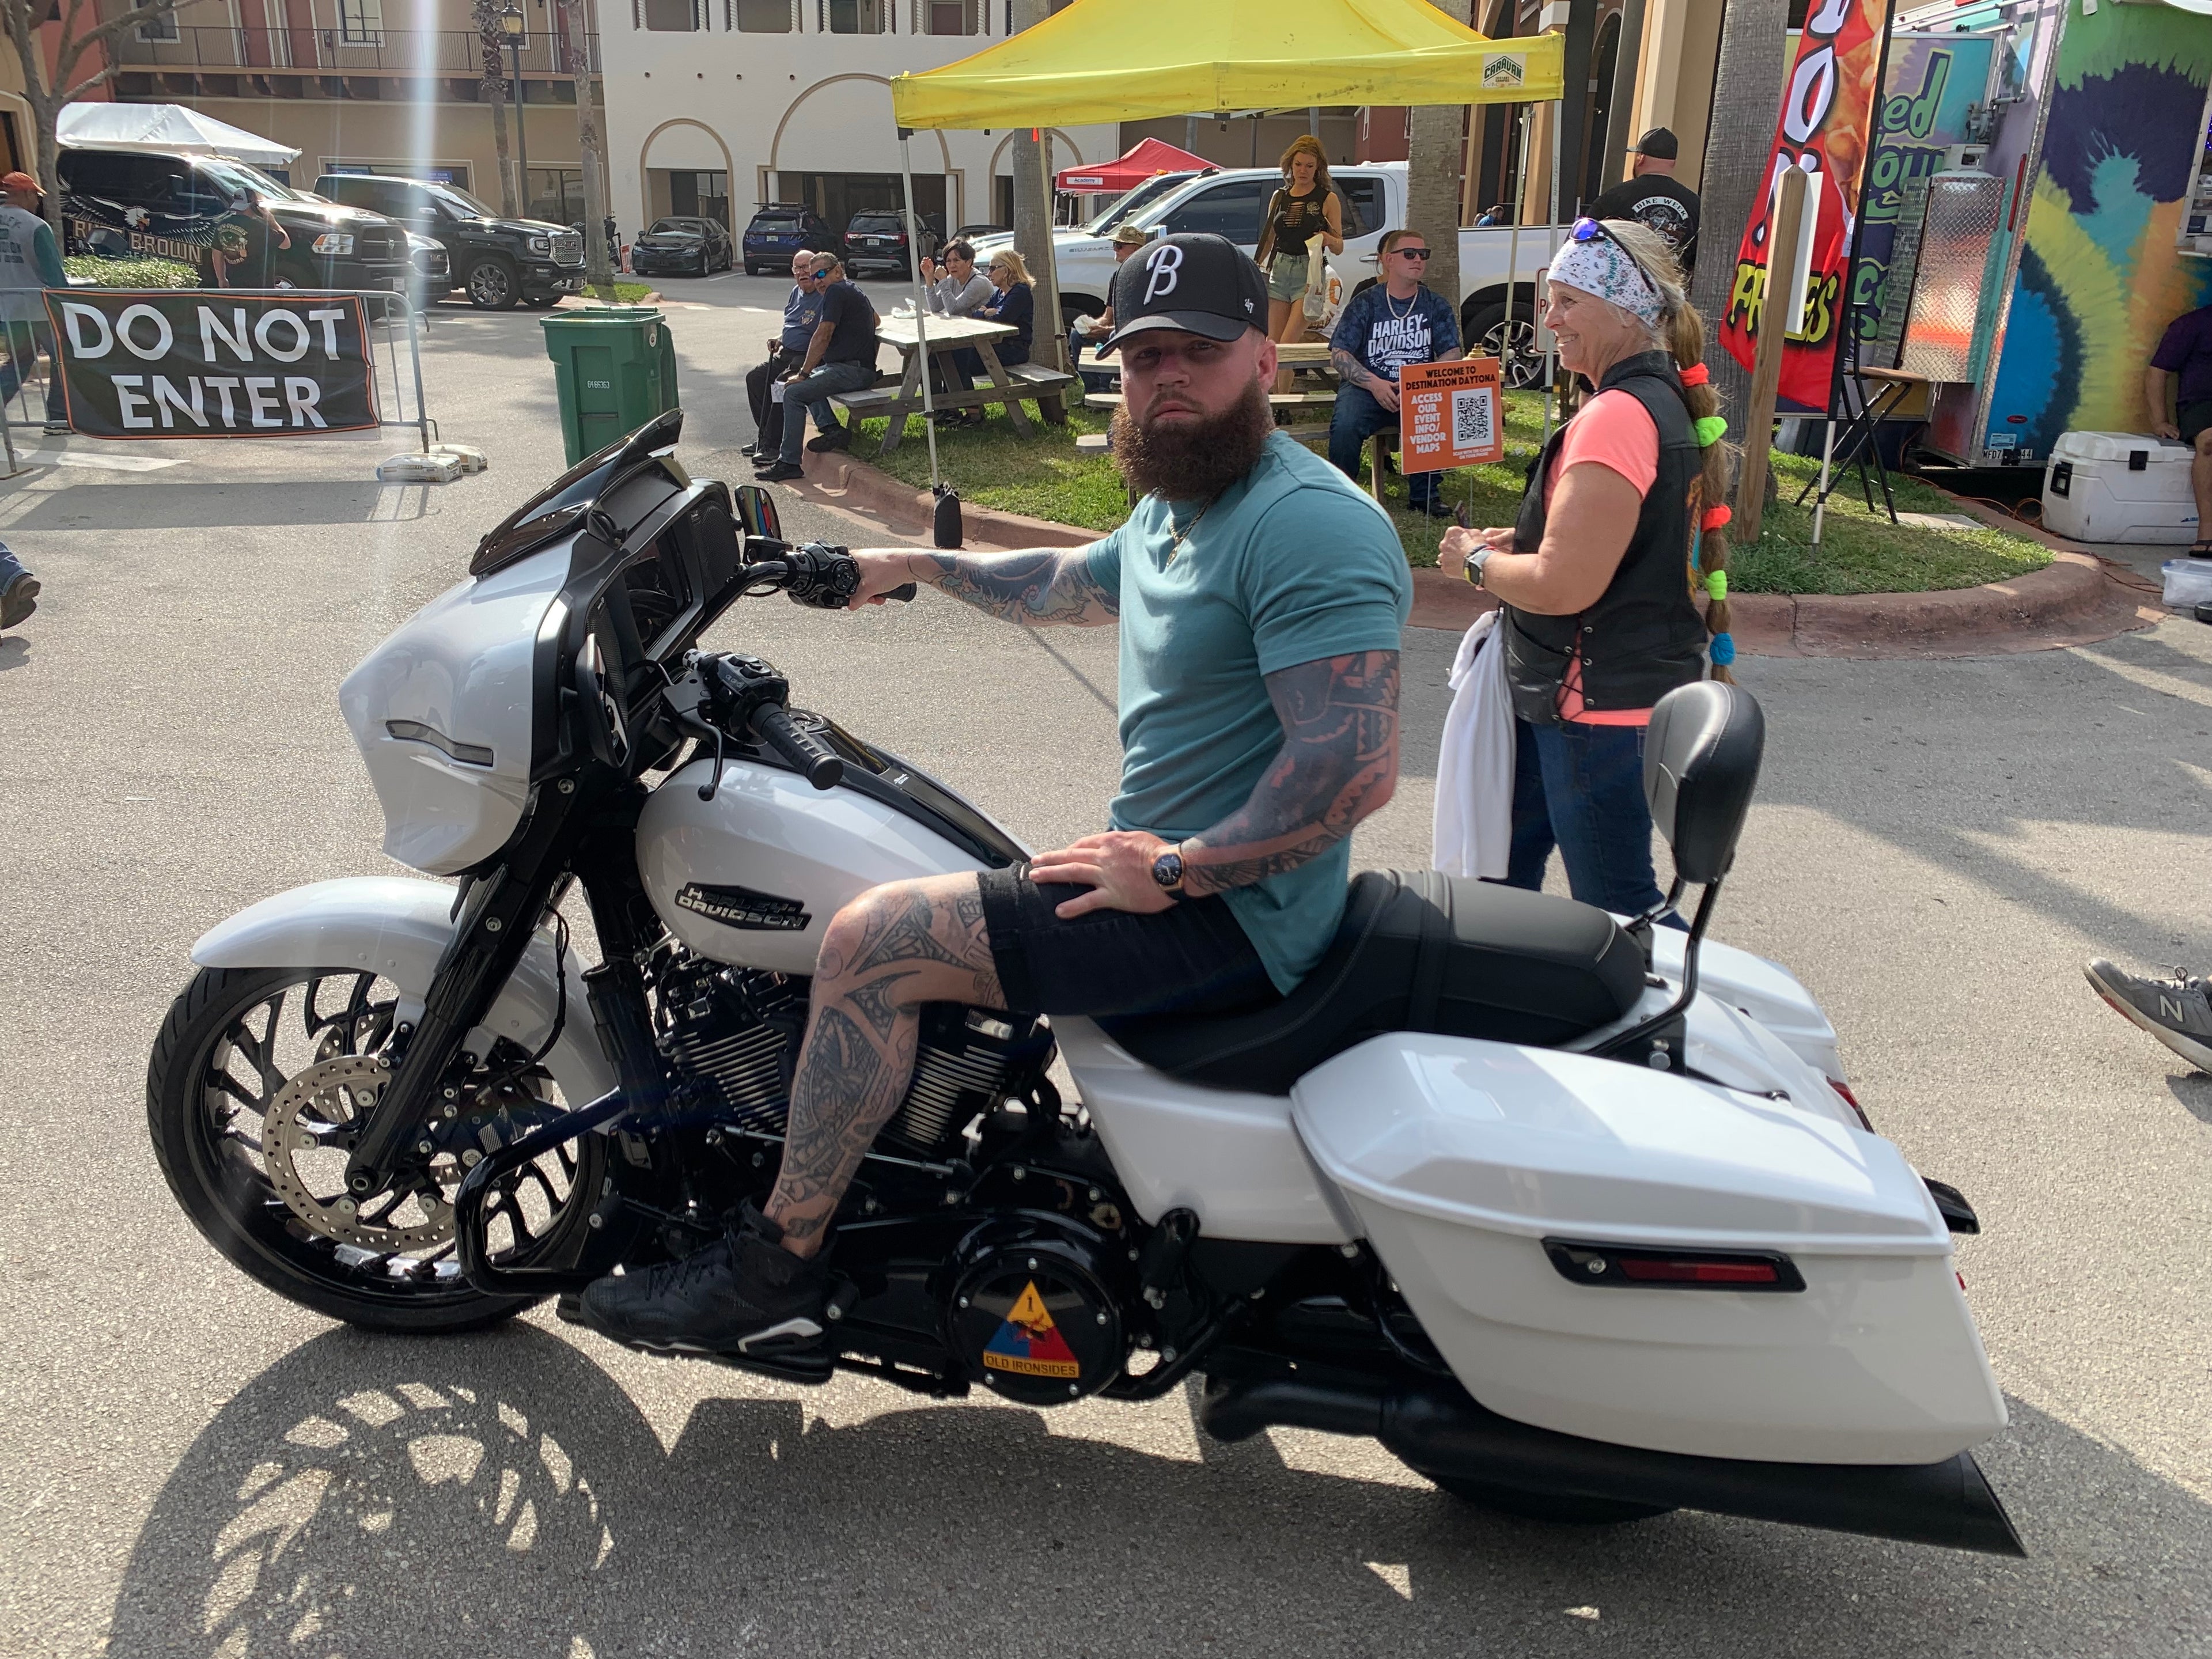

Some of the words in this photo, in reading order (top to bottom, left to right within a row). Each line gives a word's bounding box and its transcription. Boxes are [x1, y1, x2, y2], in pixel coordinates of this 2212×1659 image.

[1484, 58, 1521, 78] CARAVAN
[1636, 198, 1658, 210] BIKE
[1664, 198, 1686, 217] WEEK
[1668, 223, 1677, 231] 24
[130, 232, 201, 263] BROWN
[1143, 245, 1183, 305] B
[60, 302, 173, 361] DO
[198, 306, 345, 362] NOT
[1368, 327, 1431, 357] DAVIDSON
[1376, 349, 1423, 363] Genuine
[1426, 367, 1464, 378] WELCOME
[1465, 366, 1476, 374] TO
[1406, 377, 1457, 390] DESTINATION
[1459, 374, 1496, 385] DAYTONA
[111, 376, 328, 428] ENTER
[1411, 392, 1442, 404] ACCESS
[1418, 403, 1437, 414] OUR
[1414, 412, 1441, 424] EVENT
[1415, 422, 1440, 434] INFO/
[1410, 432, 1446, 445] VENDOR
[1416, 442, 1440, 454] MAPS
[678, 895, 804, 928] DAVIDSON
[2160, 995, 2183, 1022] N
[1027, 1296, 1033, 1313] 1
[986, 1354, 1009, 1369] OLD
[1012, 1359, 1076, 1376] IRONSIDES
